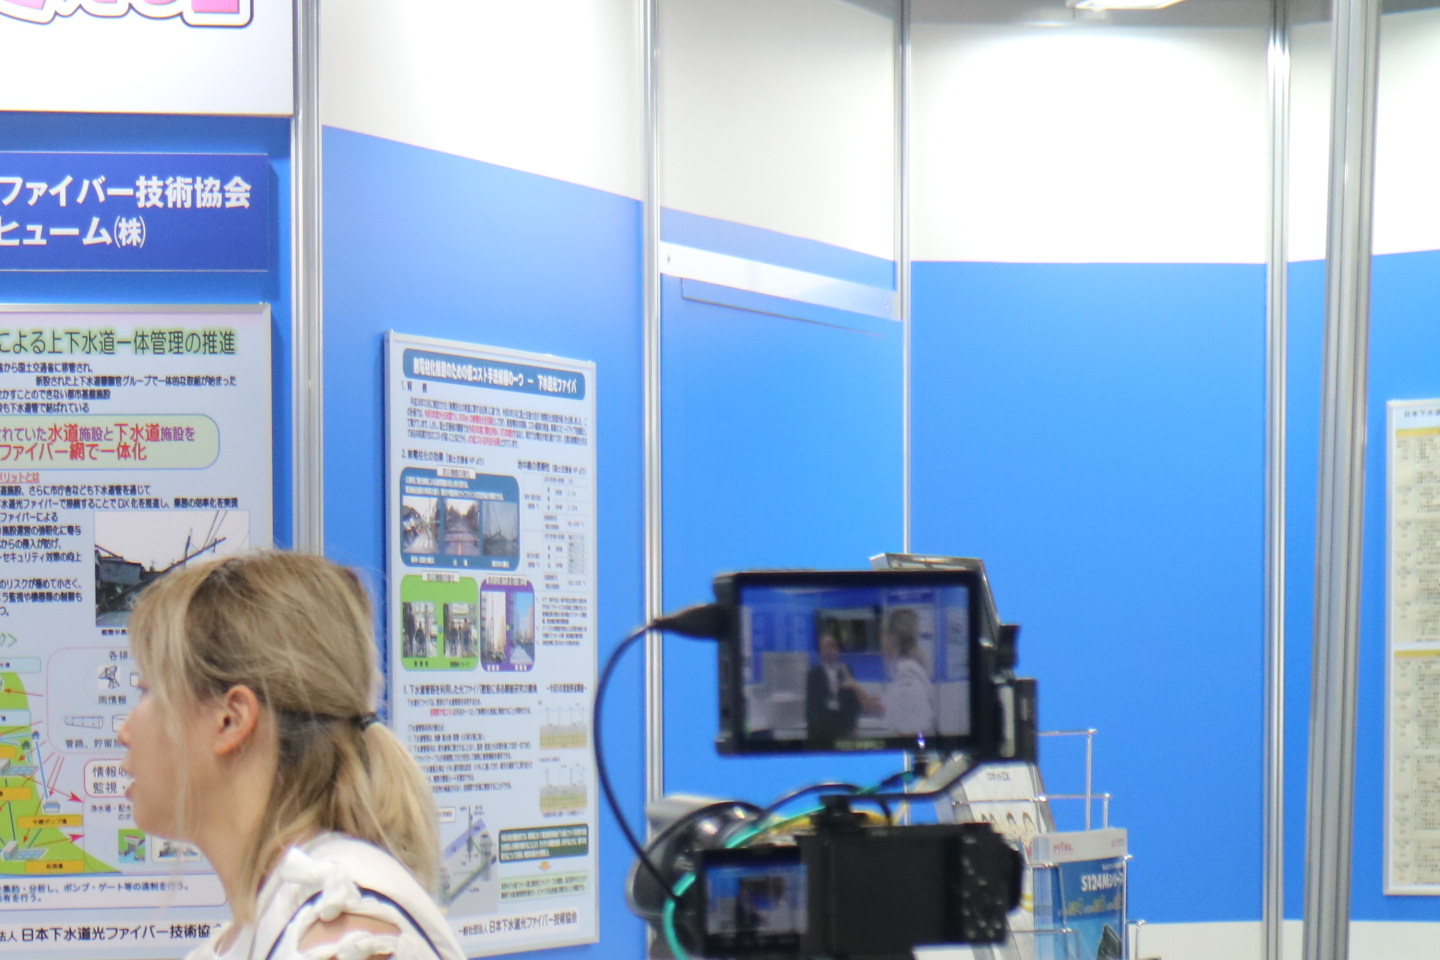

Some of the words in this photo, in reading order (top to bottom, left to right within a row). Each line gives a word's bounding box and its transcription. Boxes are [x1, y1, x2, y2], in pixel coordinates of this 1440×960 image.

[21, 923, 222, 942] 日本下水道光ファイバー技術協
